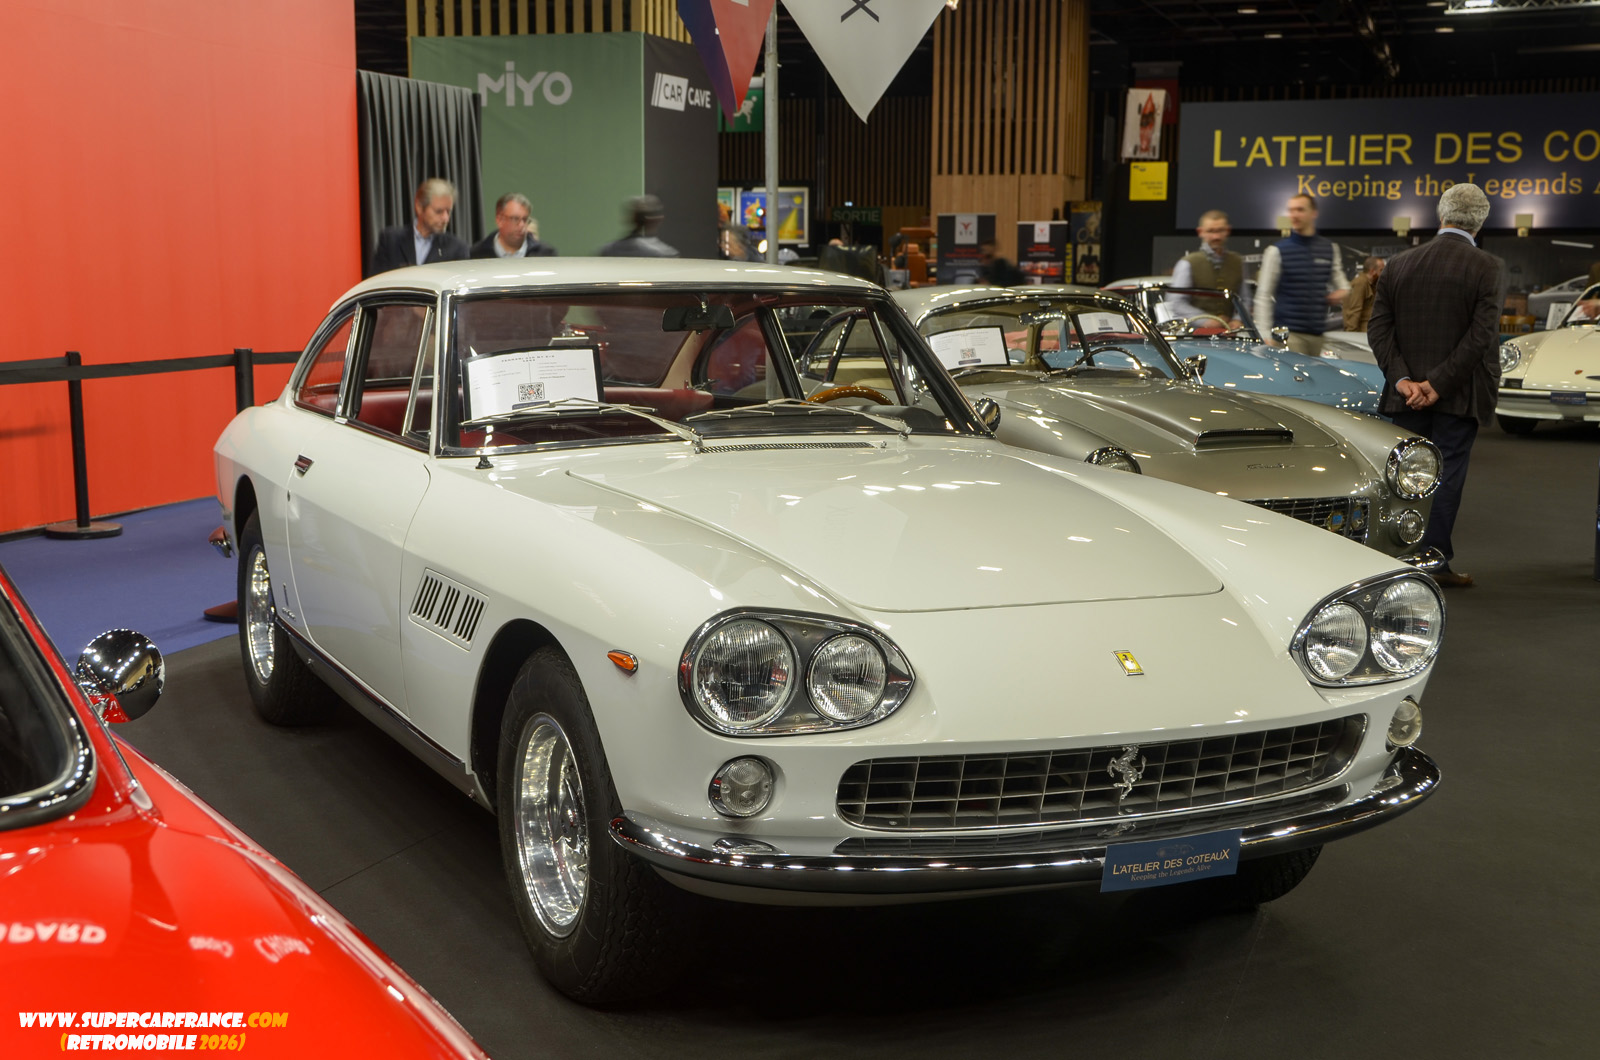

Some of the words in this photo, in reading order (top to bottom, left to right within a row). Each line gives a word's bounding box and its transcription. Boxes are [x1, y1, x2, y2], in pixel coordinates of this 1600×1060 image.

[663, 82, 684, 101] CAR
[687, 86, 712, 109] CAVE
[1213, 129, 1414, 168] L'ATELIER
[1434, 131, 1523, 166] DES
[1543, 129, 1600, 163] CO
[1297, 174, 1402, 200] Keeping
[832, 209, 880, 222] SORTIE
[1112, 861, 1160, 876] L'ATELIER
[1163, 857, 1183, 870] DES
[1186, 848, 1230, 866] COTEAUX
[1130, 872, 1157, 882] Keeping
[1158, 870, 1169, 878] the
[1169, 866, 1195, 878] Legends
[1195, 863, 1212, 873] Alive
